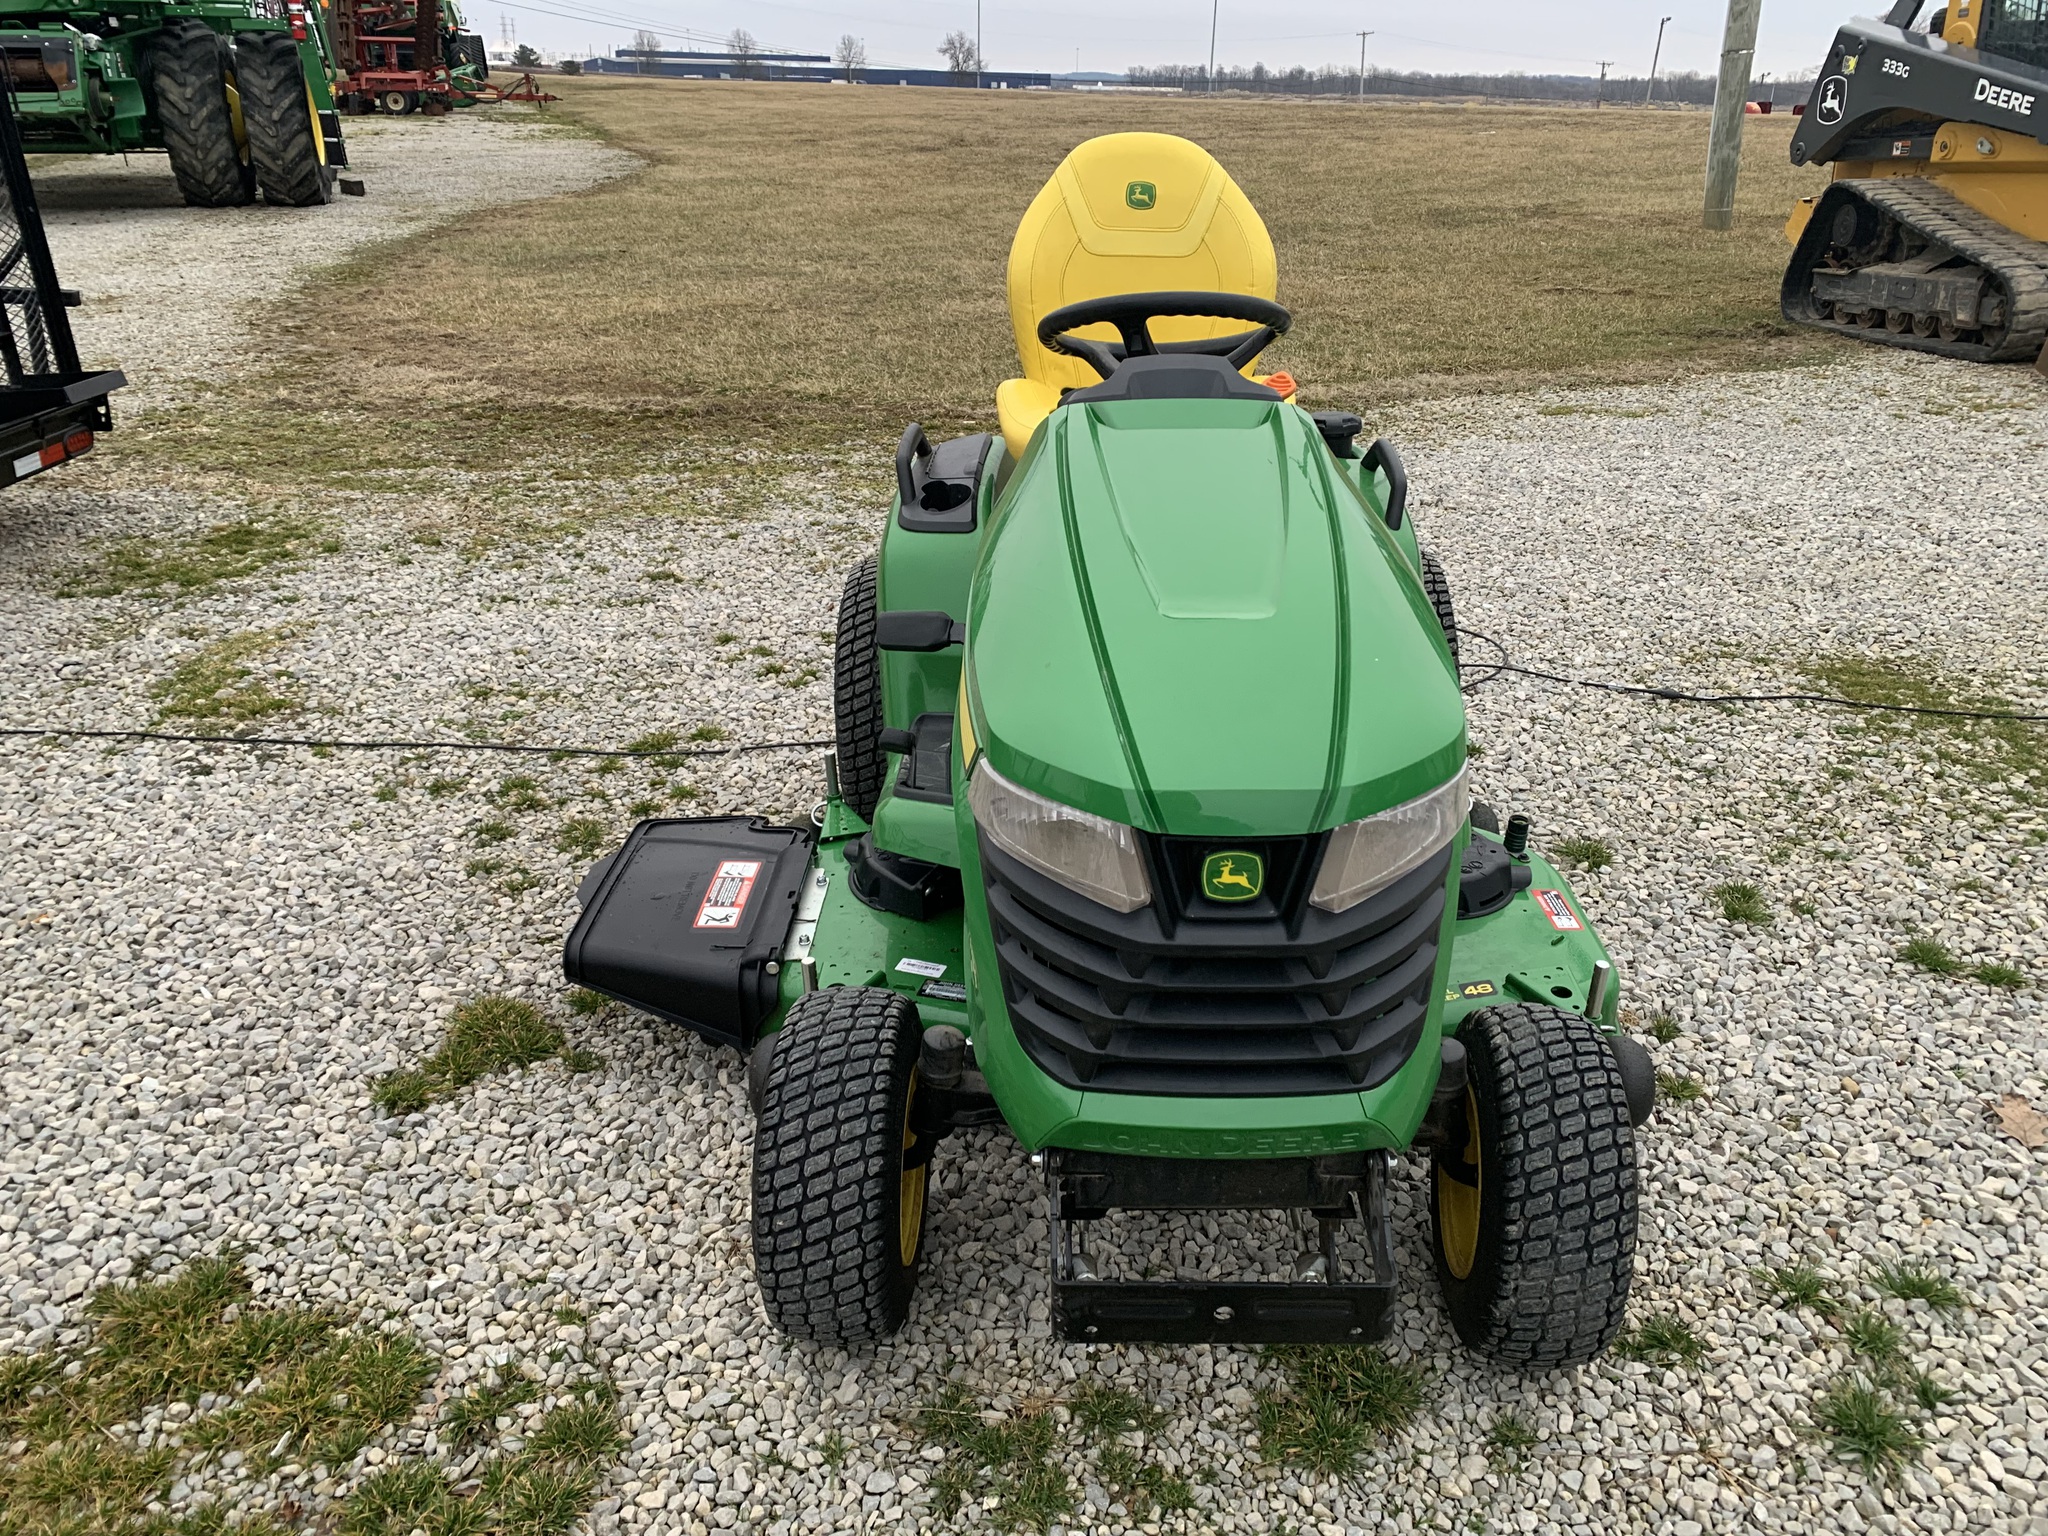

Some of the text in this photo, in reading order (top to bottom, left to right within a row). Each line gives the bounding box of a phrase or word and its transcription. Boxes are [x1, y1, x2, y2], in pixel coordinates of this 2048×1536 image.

[1882, 58, 1910, 78] 333G
[1974, 77, 2035, 115] DEERE
[1464, 983, 1493, 995] 48
[1083, 1132, 1360, 1155] JOHN DEERE
